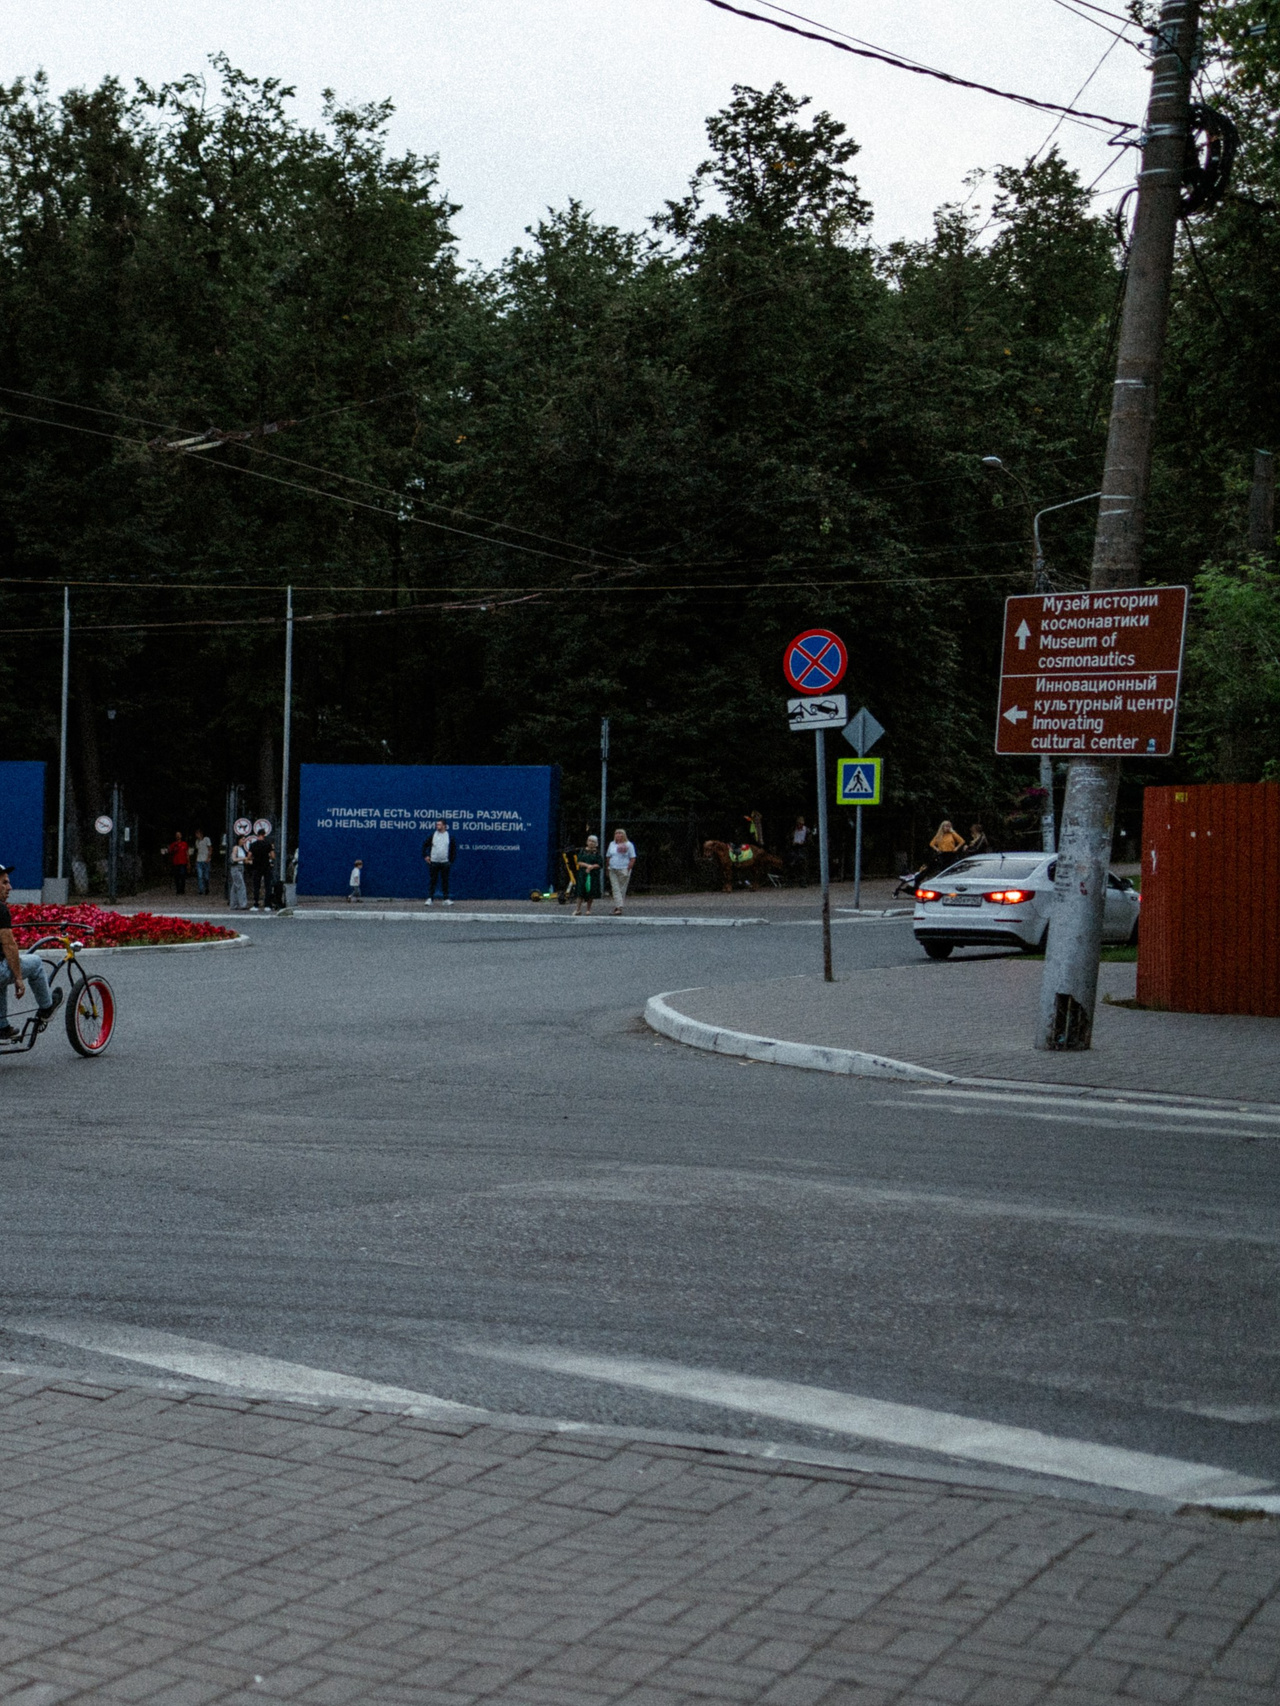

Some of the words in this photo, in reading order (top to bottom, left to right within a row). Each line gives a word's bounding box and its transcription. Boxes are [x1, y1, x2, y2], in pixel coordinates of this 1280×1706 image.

[1043, 596, 1089, 614] Музей
[1094, 595, 1158, 610] истории
[1041, 615, 1149, 630] космонавтики
[1039, 634, 1097, 650] Museum
[1102, 632, 1117, 647] of
[1038, 652, 1135, 668] cosmonautics
[1036, 676, 1157, 692] Инновационный
[1034, 696, 1122, 714] культурный
[1127, 699, 1174, 713] центр
[1032, 716, 1104, 734] Innovating
[1031, 734, 1086, 749] cultural
[1090, 735, 1139, 749] center
[383, 808, 411, 818] ЕСТЬ
[413, 809, 474, 819] КОЛЫБЕЛЬ
[317, 819, 333, 828] НО
[335, 819, 377, 828] НЕЛЬЗЯ
[380, 820, 417, 829] ВЕЧНО
[418, 820, 450, 830] ЖИЬ
[452, 821, 460, 831] В
